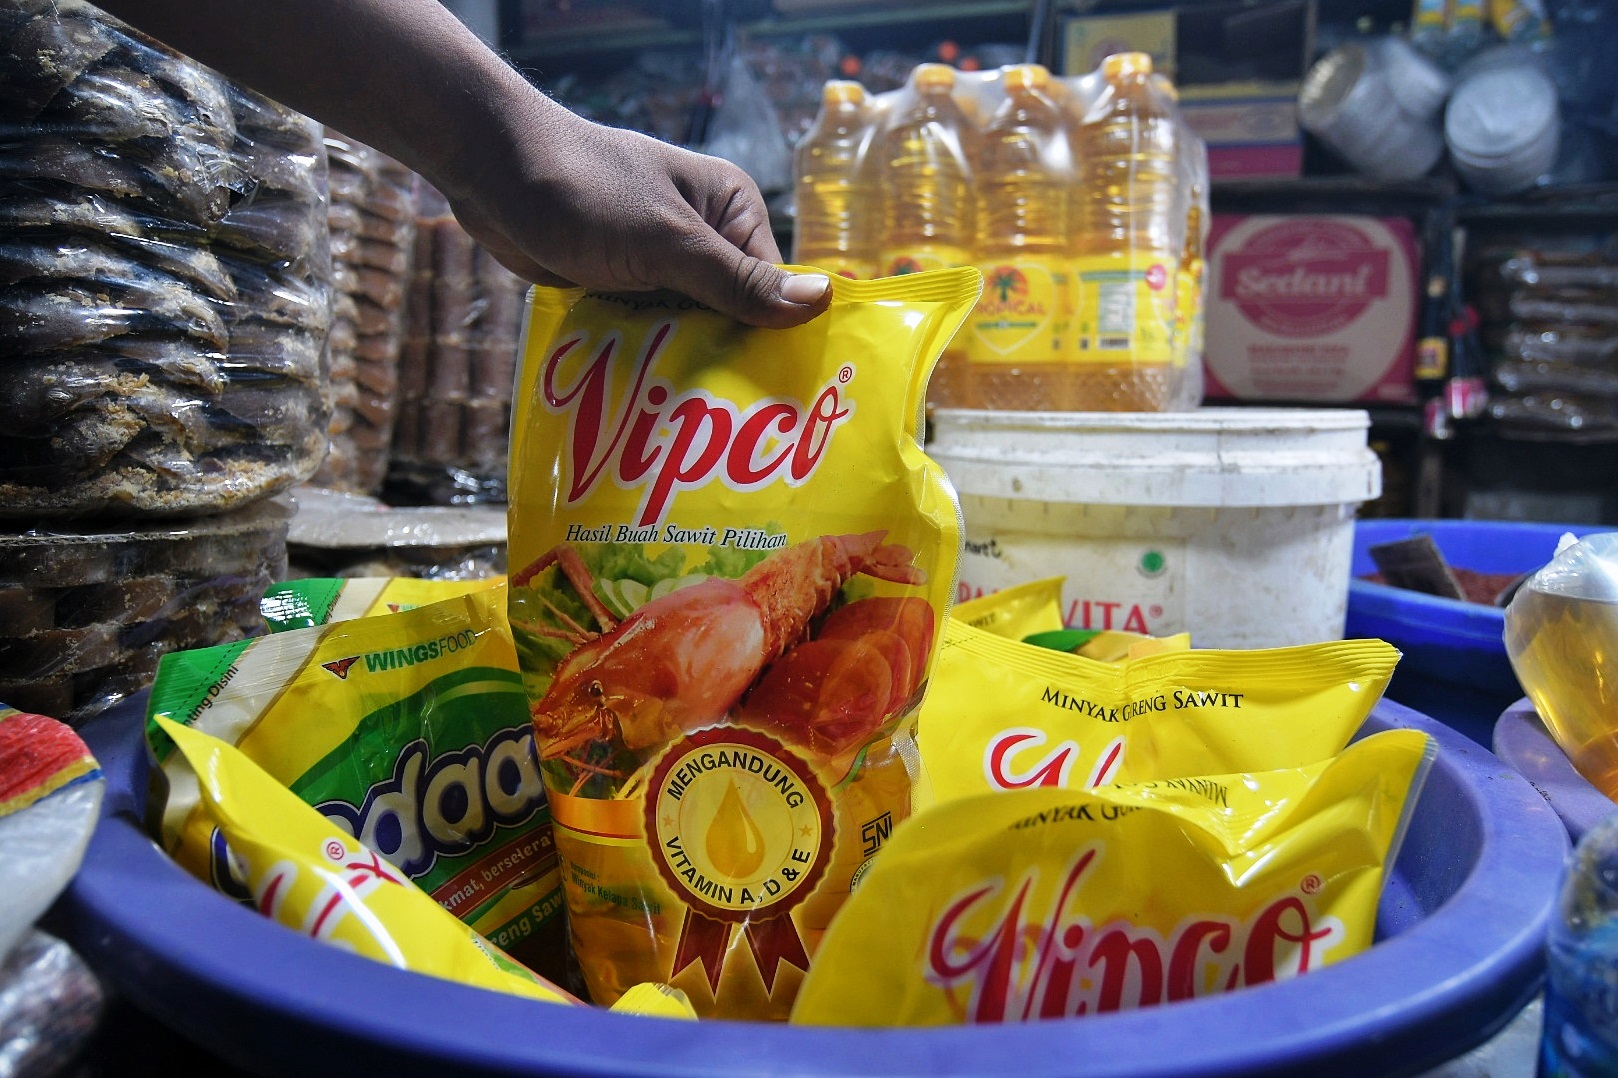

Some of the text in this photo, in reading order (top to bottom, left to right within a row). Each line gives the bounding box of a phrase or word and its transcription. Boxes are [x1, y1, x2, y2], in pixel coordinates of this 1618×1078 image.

[544, 324, 848, 527] Vipco
[565, 525, 786, 549] Hasil Buah Sawit Pilihan
[208, 662, 240, 697] Disini
[1041, 686, 1244, 723] MINYAK GRENG SAWIT
[666, 751, 804, 809] MENGANDUNG
[862, 814, 893, 855] SNI
[666, 836, 733, 904] VITAMIN
[781, 867, 801, 882] &
[791, 848, 811, 864] E
[531, 890, 563, 922] Saw
[597, 886, 629, 908] Kelapa
